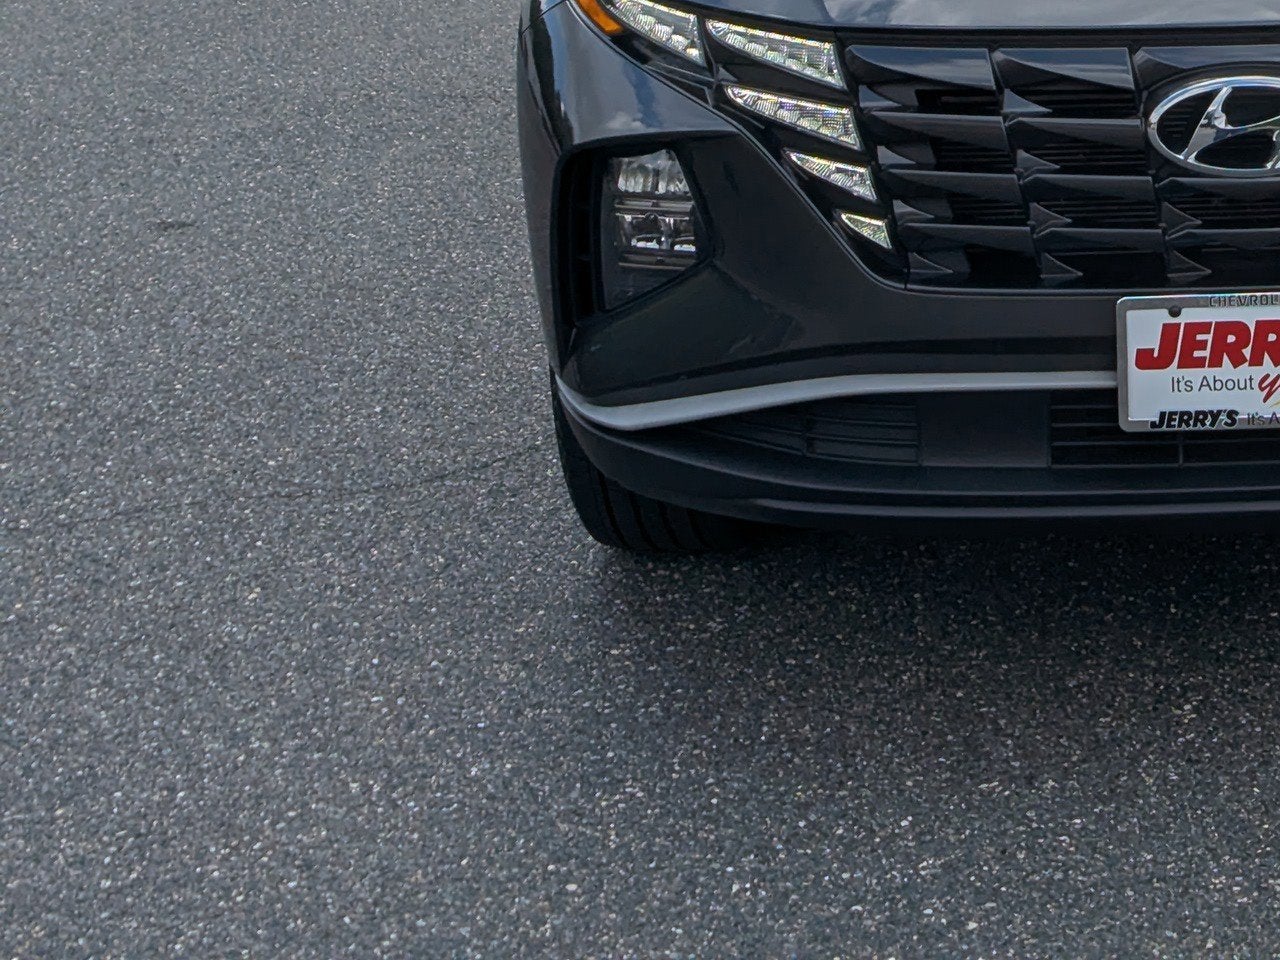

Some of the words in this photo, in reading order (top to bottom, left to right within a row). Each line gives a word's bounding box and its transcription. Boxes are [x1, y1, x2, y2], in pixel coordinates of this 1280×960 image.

[1171, 376, 1194, 393] It's
[1198, 374, 1254, 392] About
[1150, 409, 1239, 429] JERRY'S
[1247, 412, 1265, 425] It's
